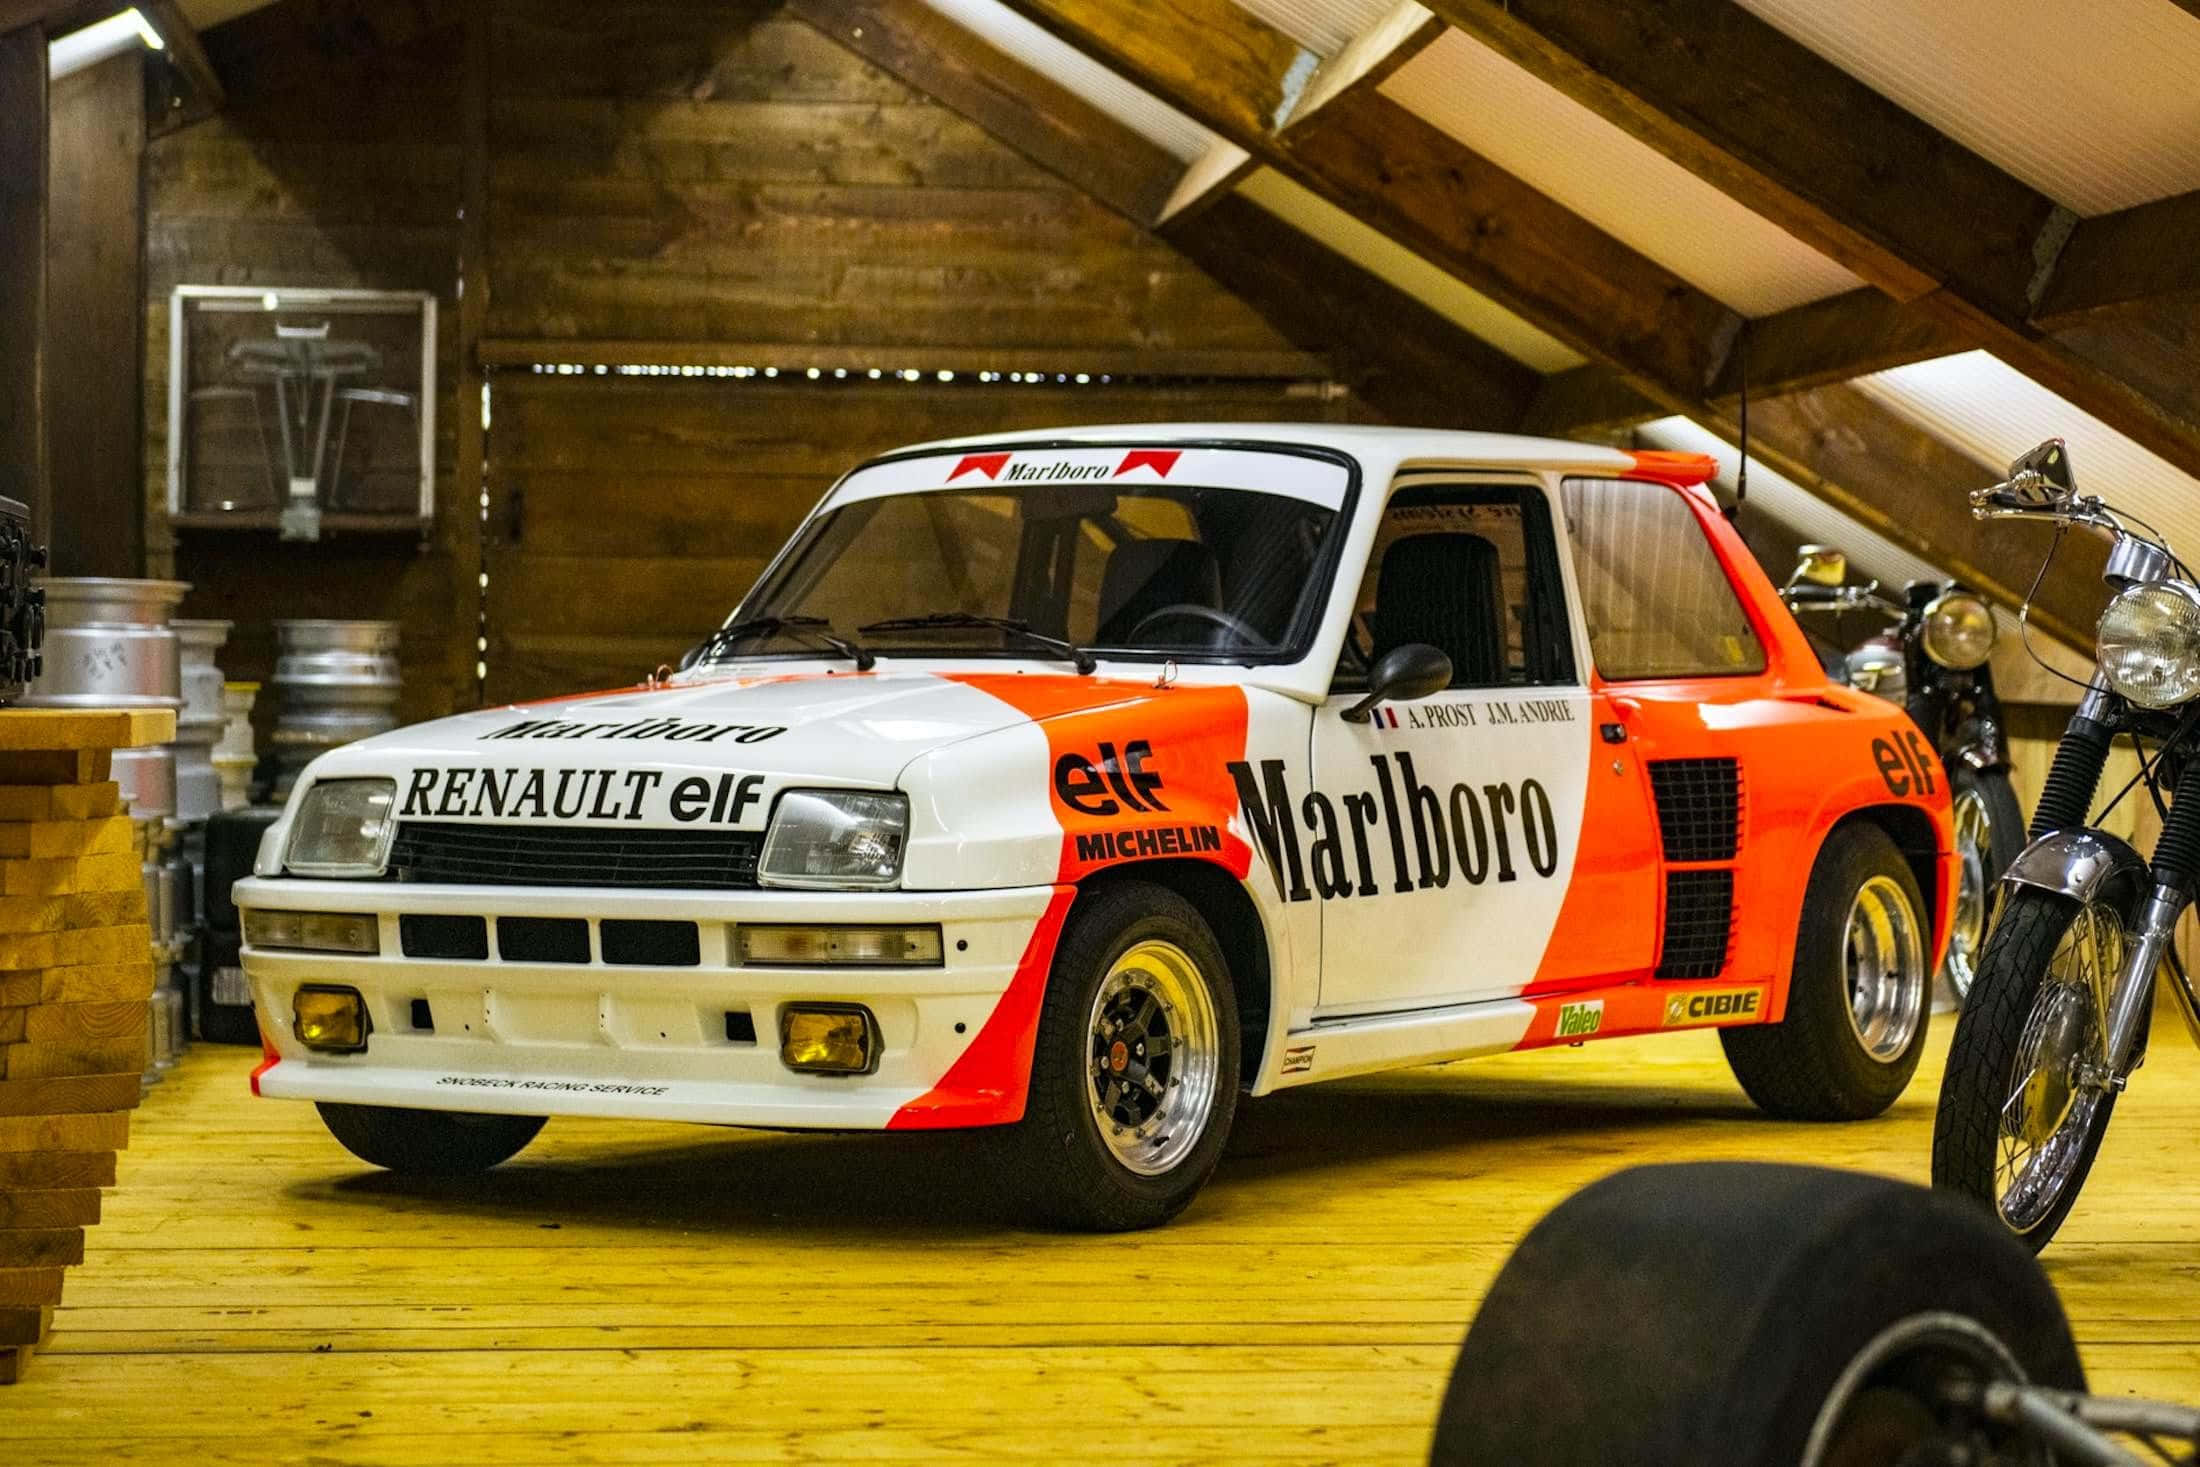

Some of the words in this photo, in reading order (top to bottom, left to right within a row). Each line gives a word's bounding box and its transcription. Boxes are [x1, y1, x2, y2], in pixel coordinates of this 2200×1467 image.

[1003, 461, 1110, 481] Marlboro
[477, 717, 788, 744] Marlboro
[1054, 739, 1172, 816] elf
[1870, 730, 1935, 797] elf
[400, 767, 664, 820] RENAULT
[669, 772, 766, 824] elf
[1076, 825, 1222, 861] MICHELIN
[1226, 750, 1558, 903] Marlboro
[1559, 1003, 1601, 1035] Valeo
[436, 1076, 517, 1089] SNOBECK
[519, 1080, 589, 1093] RACING
[589, 1083, 670, 1097] SERVICE
